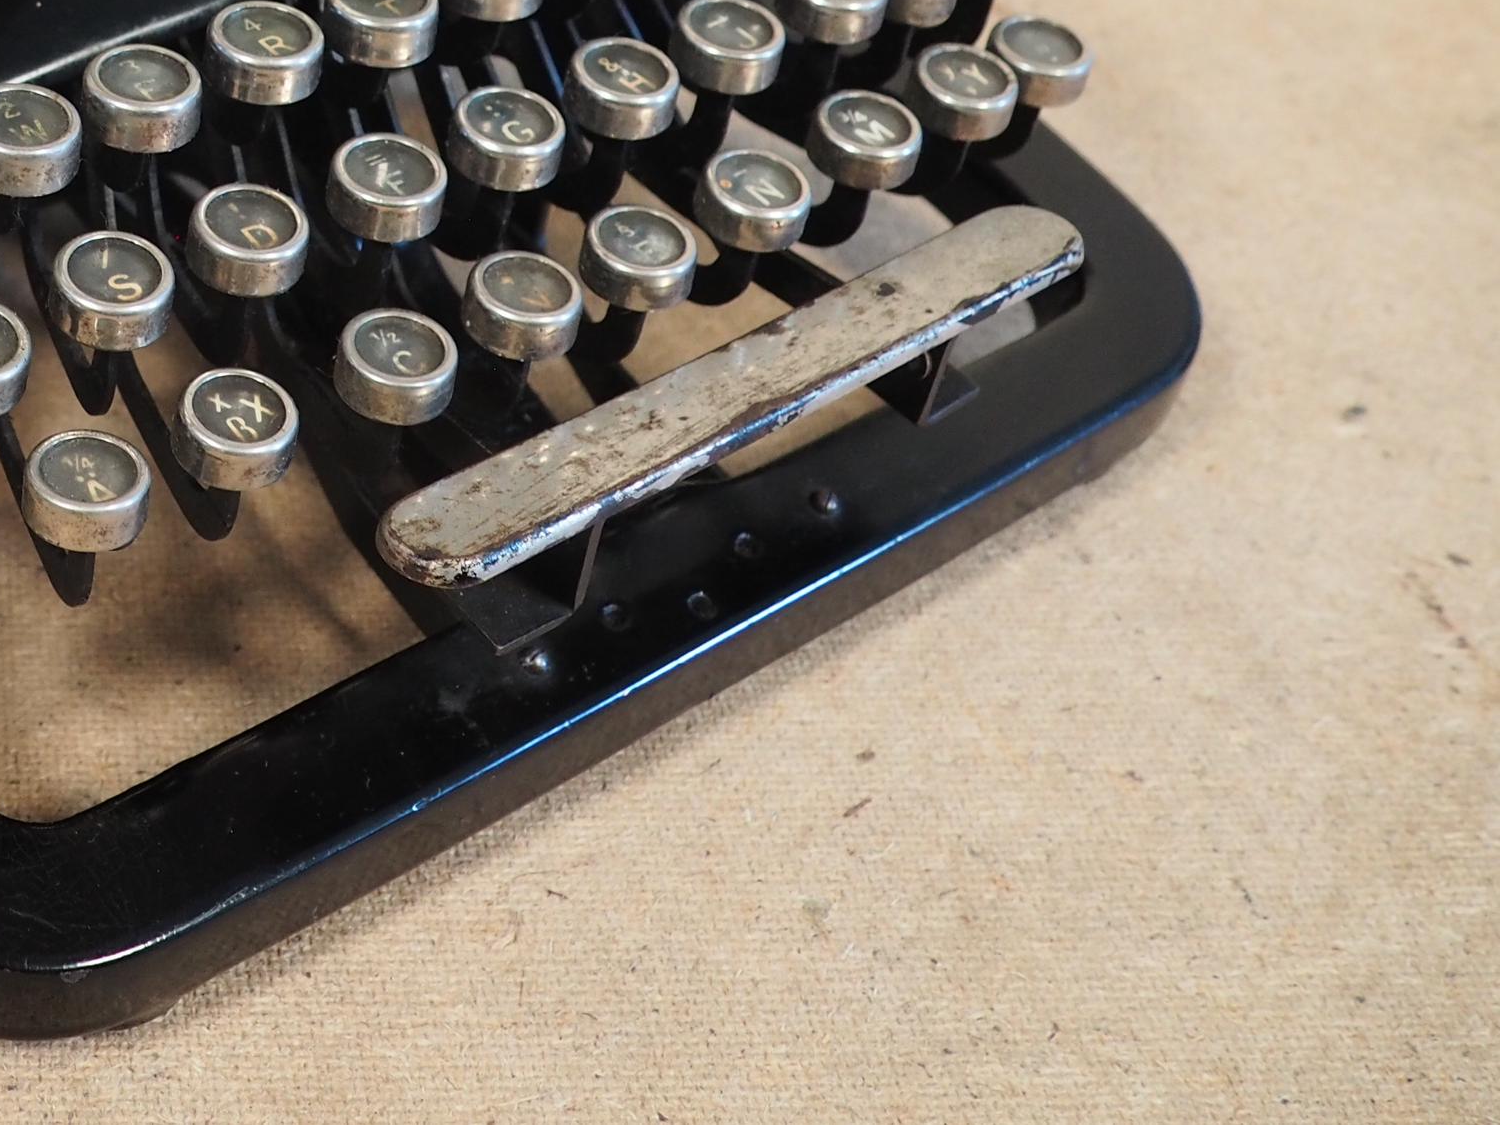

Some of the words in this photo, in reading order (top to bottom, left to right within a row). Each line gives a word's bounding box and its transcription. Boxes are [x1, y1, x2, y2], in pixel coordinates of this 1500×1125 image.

[243, 17, 262, 33] 4
[257, 34, 295, 56] R
[617, 71, 657, 94] H
[501, 120, 535, 143] G
[855, 120, 896, 144] M
[745, 179, 785, 206] N
[241, 222, 277, 249] D
[108, 274, 143, 301] S
[76, 471, 118, 502] Ä
